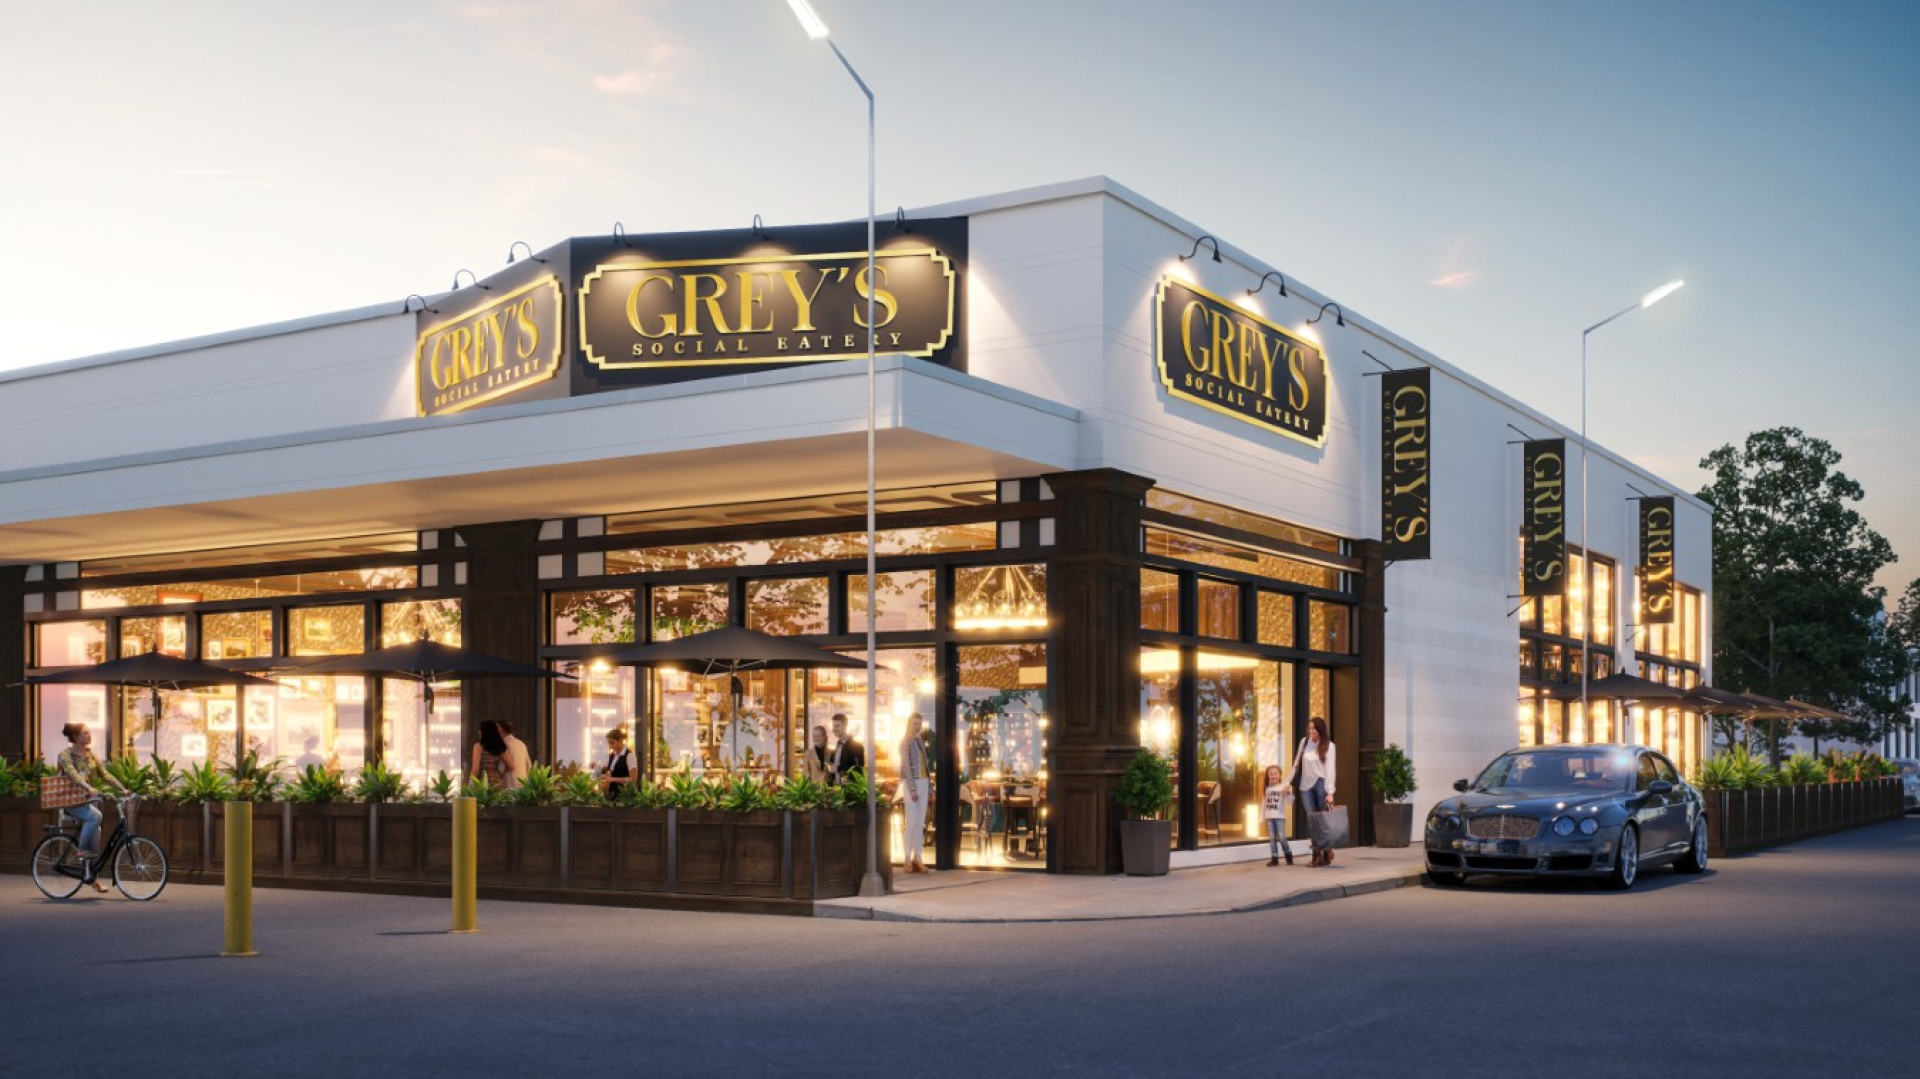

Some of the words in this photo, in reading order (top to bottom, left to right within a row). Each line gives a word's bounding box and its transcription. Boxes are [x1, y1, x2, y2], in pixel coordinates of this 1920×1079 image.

[431, 297, 539, 391] GREY'S
[626, 264, 898, 339] GREY'S
[632, 338, 748, 356] SOCIAL
[434, 381, 479, 408] SOCIAL
[487, 358, 540, 388] EATERY
[1180, 299, 1310, 411] GREY'S
[1184, 372, 1245, 407] SOCIAL
[1255, 402, 1310, 431] EATERY
[1393, 385, 1428, 543] GREY'S
[1533, 452, 1562, 582] GREY'S
[1647, 507, 1673, 613] GREY'S
